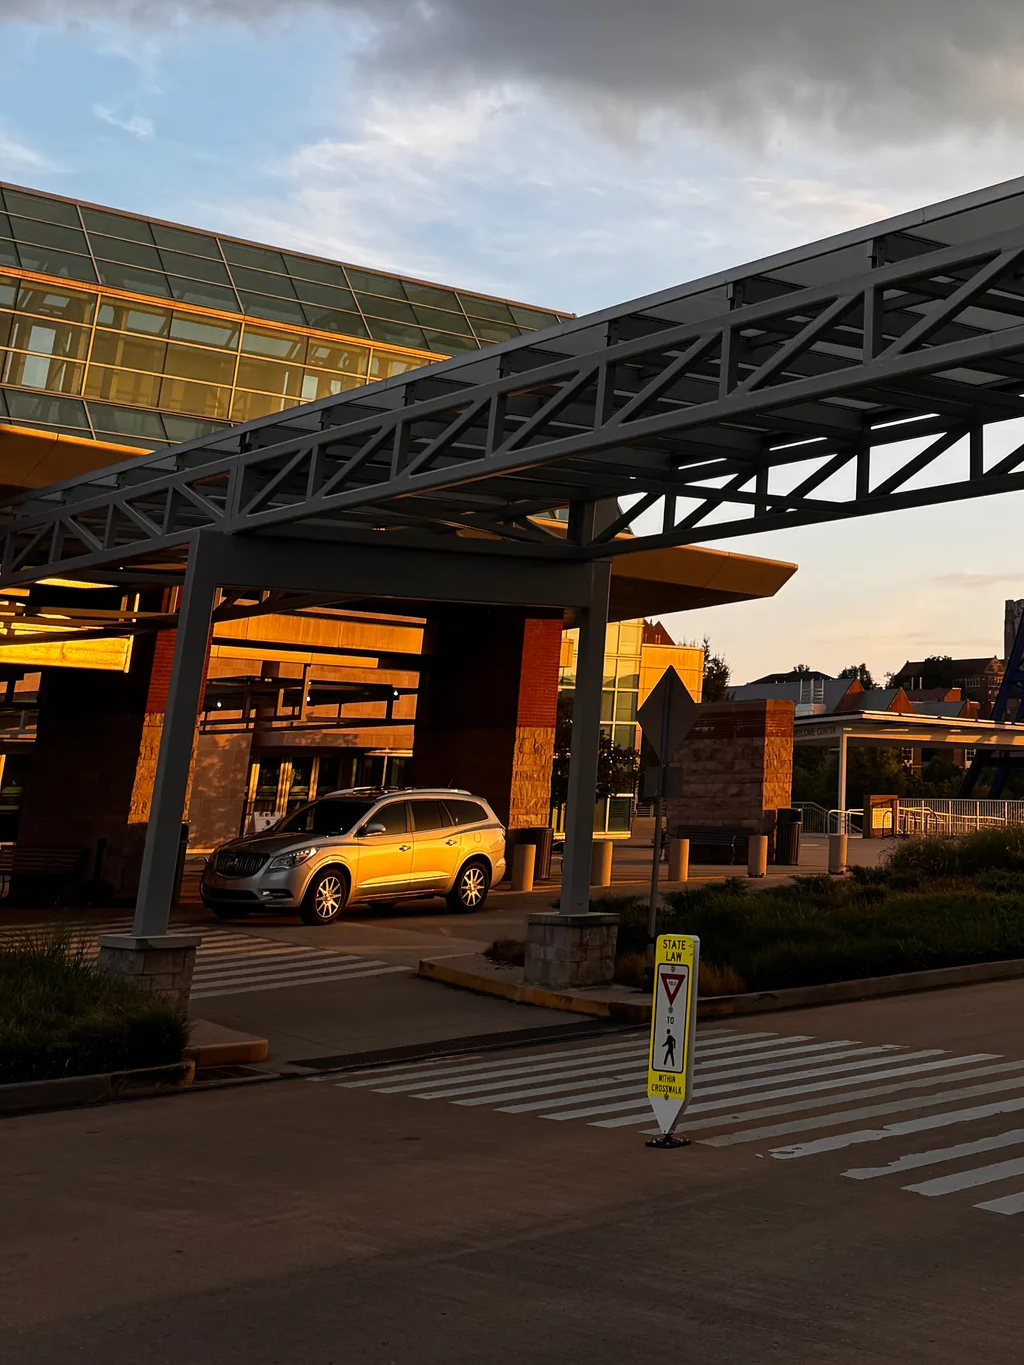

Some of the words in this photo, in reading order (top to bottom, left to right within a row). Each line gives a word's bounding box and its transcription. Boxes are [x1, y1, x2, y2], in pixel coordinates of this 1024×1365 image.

[816, 725, 837, 736] CENTER
[663, 939, 686, 950] STATE
[665, 951, 683, 962] LAW
[666, 1016, 675, 1024] TO
[658, 1074, 676, 1083] WITHIN
[651, 1083, 682, 1095] CROSSWALK
